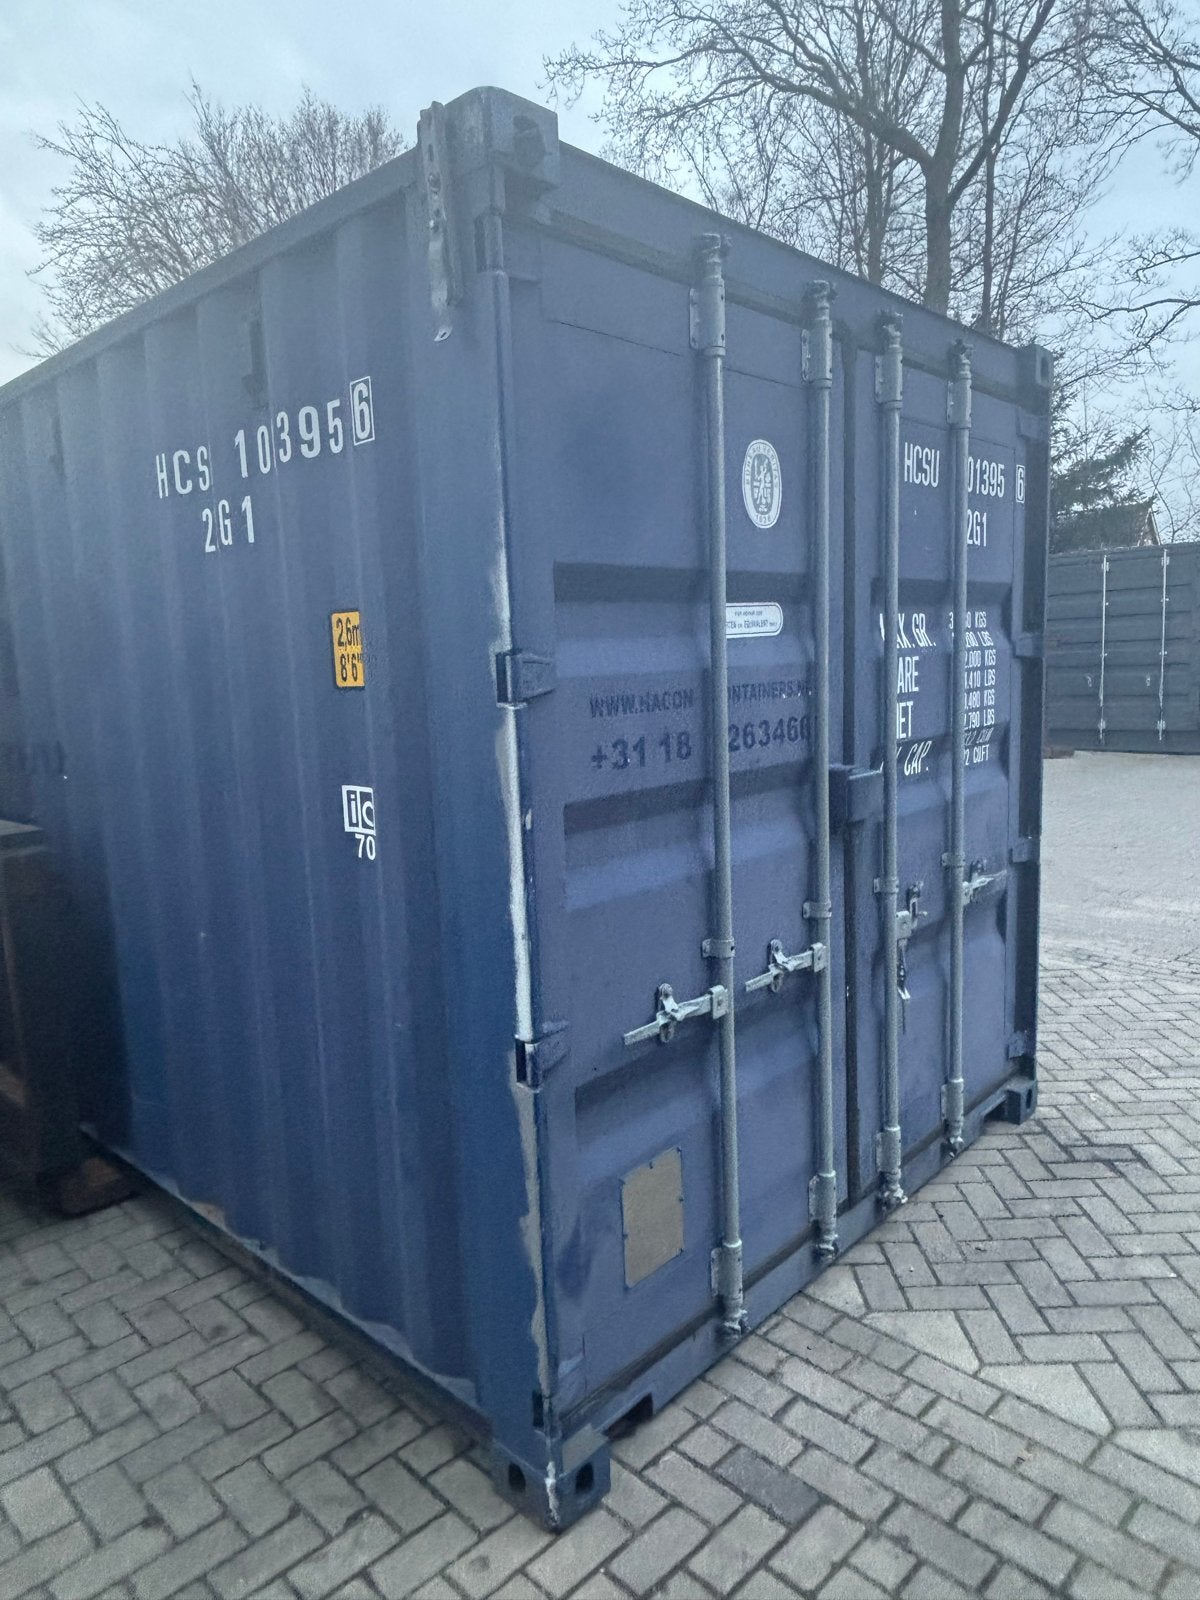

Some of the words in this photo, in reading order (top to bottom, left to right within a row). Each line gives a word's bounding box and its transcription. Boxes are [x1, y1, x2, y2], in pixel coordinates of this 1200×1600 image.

[352, 381, 373, 441] 6
[904, 442, 940, 488] HCSU
[967, 456, 1005, 498] 01395
[1017, 466, 1025, 501] 6
[967, 509, 987, 547] 2G1
[897, 656, 920, 694] ARE
[591, 736, 646, 770] +31
[659, 729, 692, 764] 18
[355, 833, 376, 861] 70
